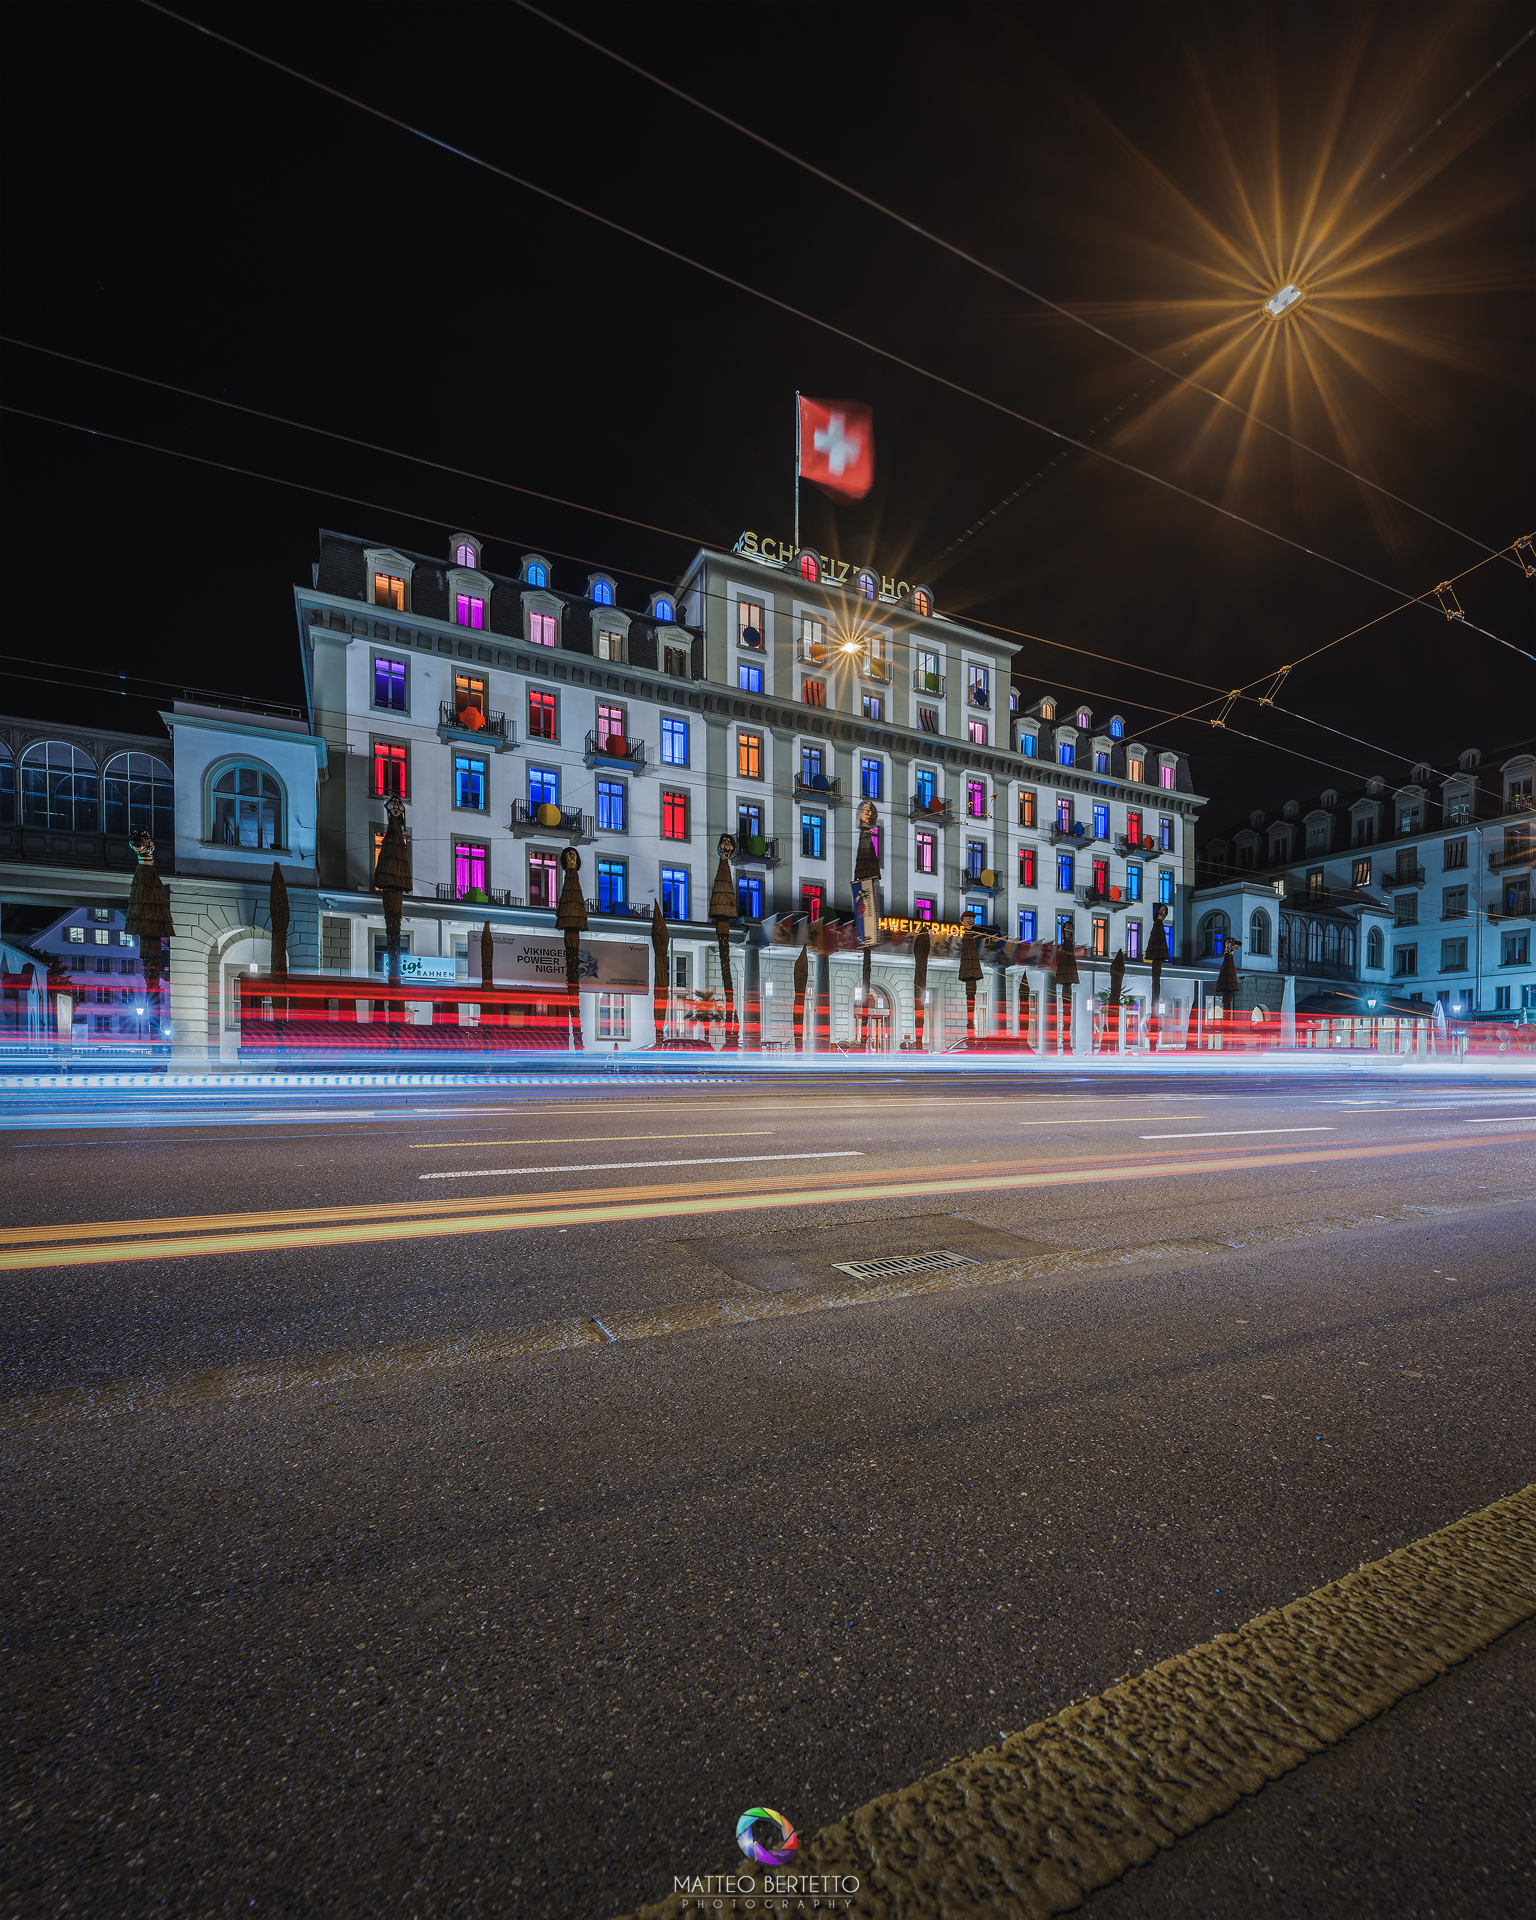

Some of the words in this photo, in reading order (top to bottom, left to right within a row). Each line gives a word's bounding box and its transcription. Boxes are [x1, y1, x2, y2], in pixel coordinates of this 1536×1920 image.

[517, 955, 560, 965] POWER
[416, 970, 455, 978] BAHNEN
[535, 965, 567, 974] NIGHT
